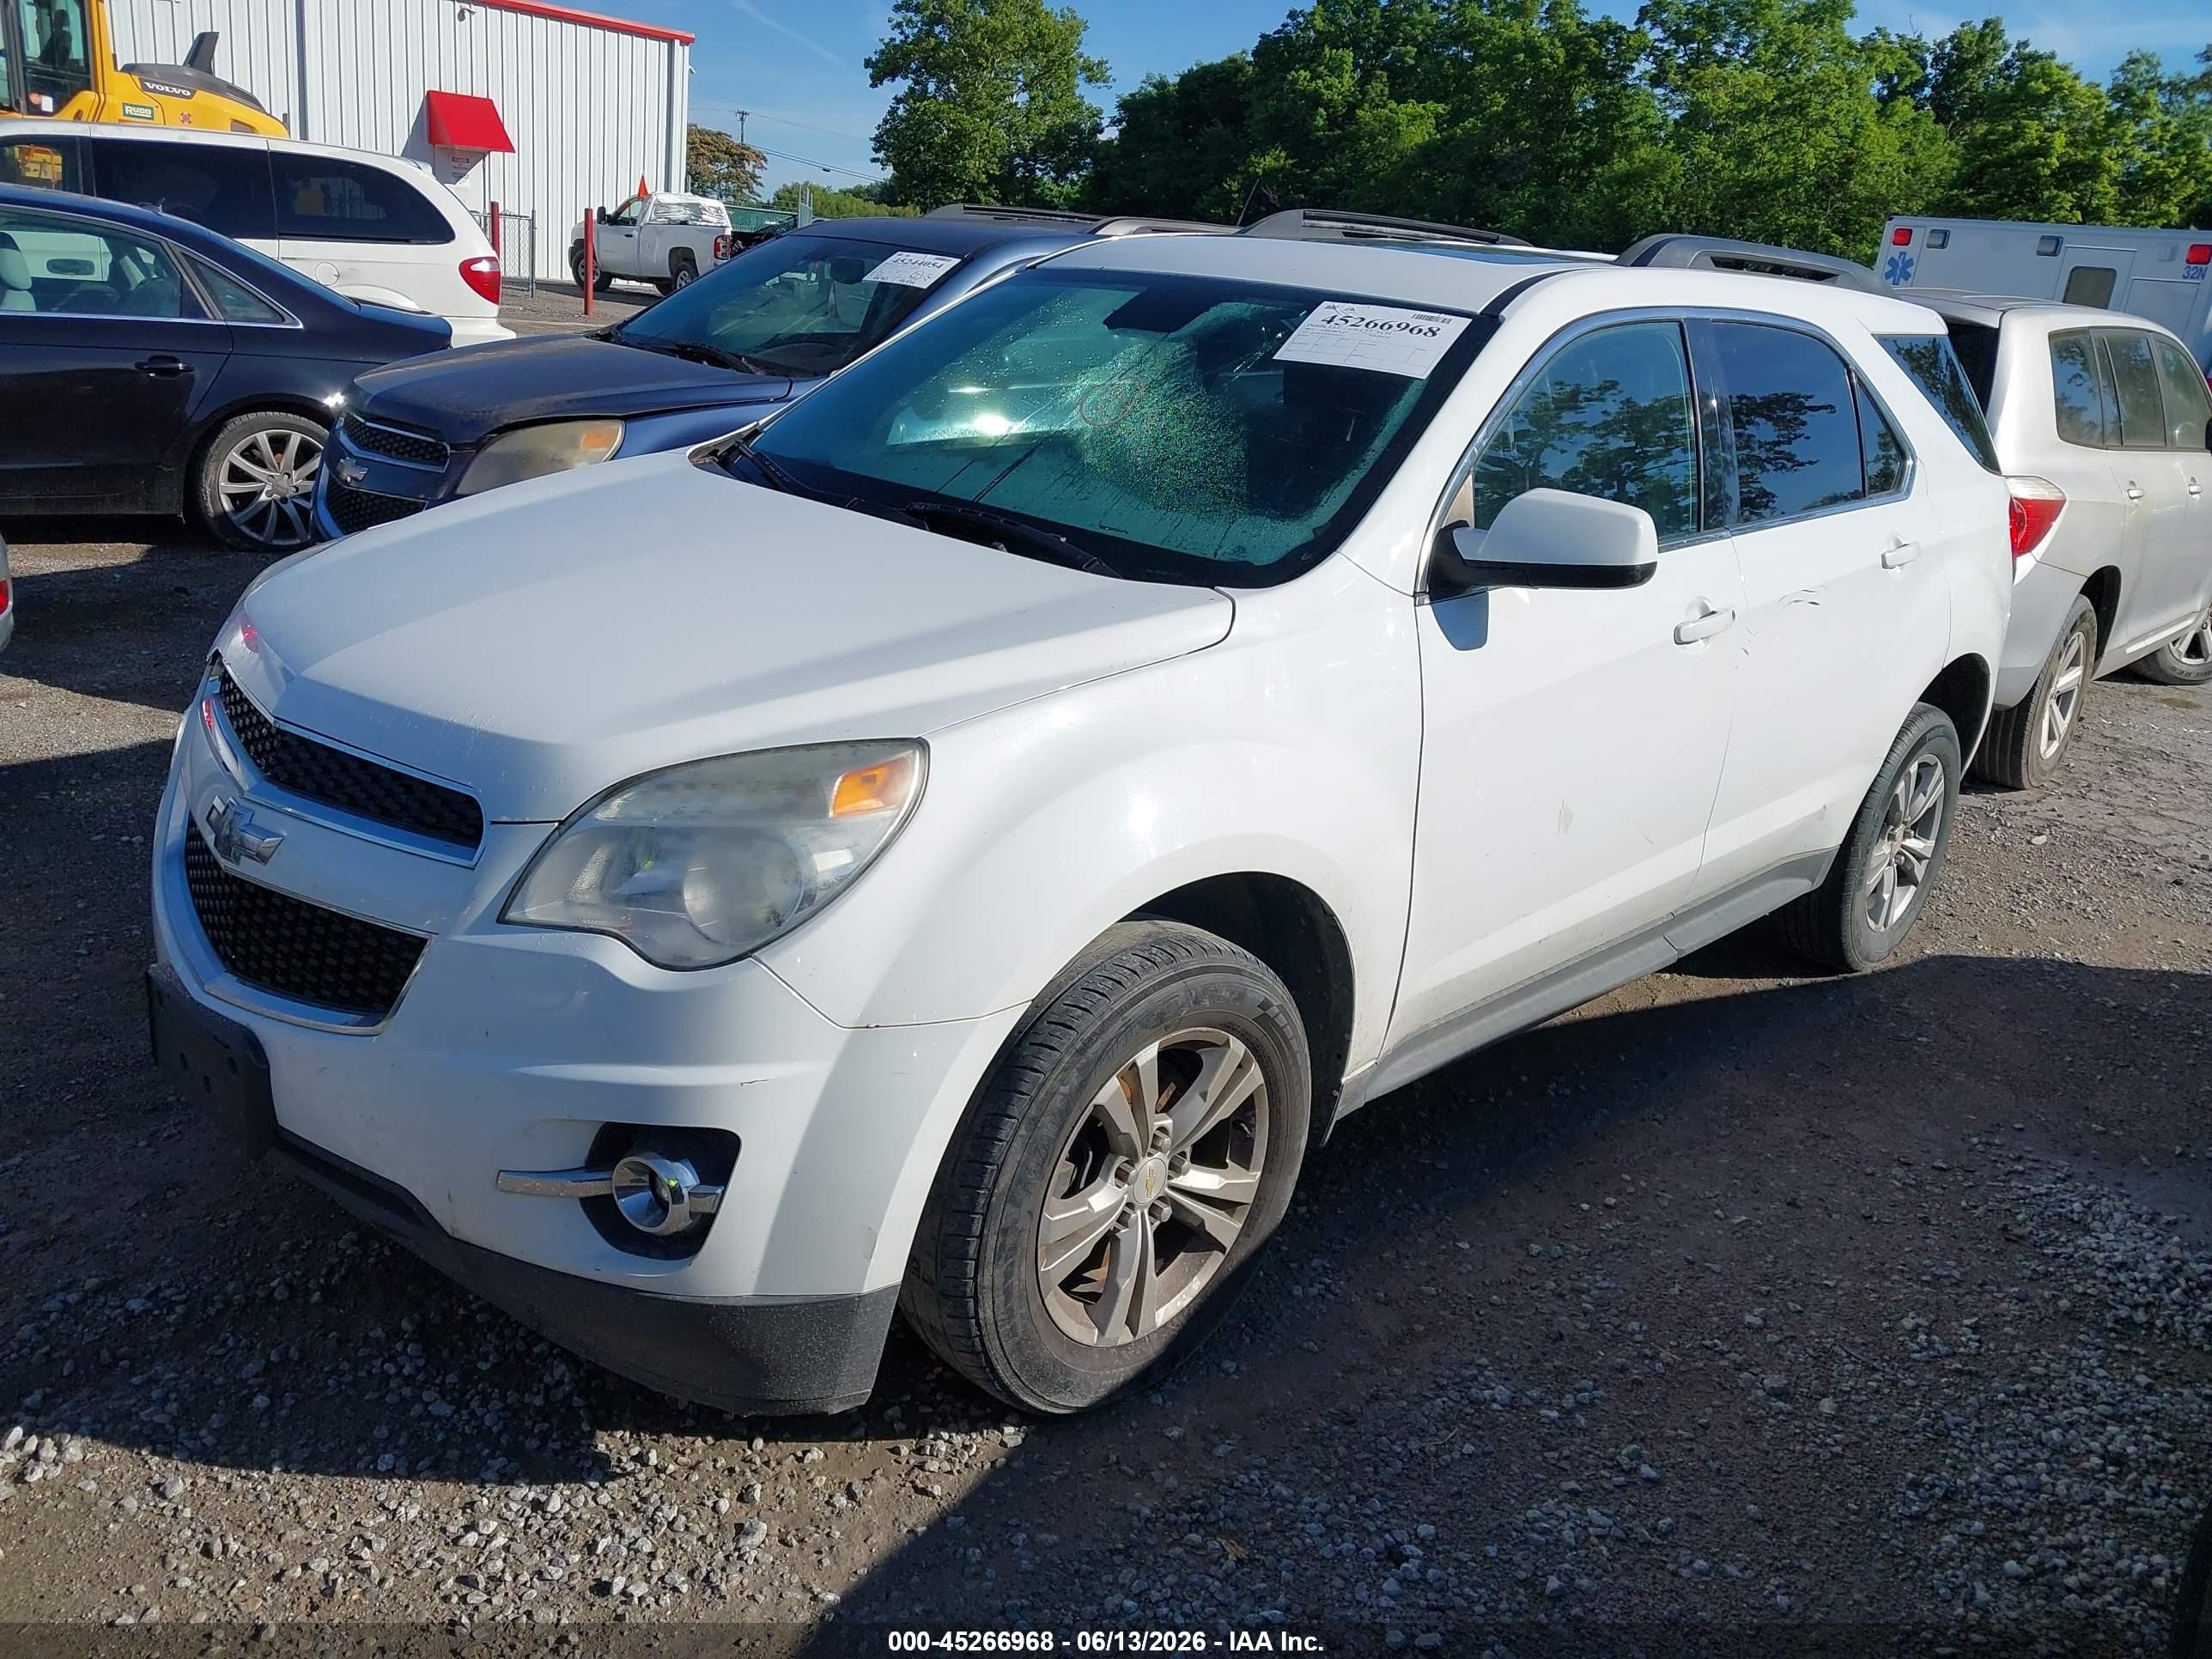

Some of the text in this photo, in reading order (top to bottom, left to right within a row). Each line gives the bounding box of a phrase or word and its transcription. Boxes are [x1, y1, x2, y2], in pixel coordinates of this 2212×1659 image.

[143, 82, 191, 96] VOLVO
[125, 105, 152, 118] RUDD
[2182, 265, 2208, 280] 32N
[1321, 313, 1442, 339] 45266968
